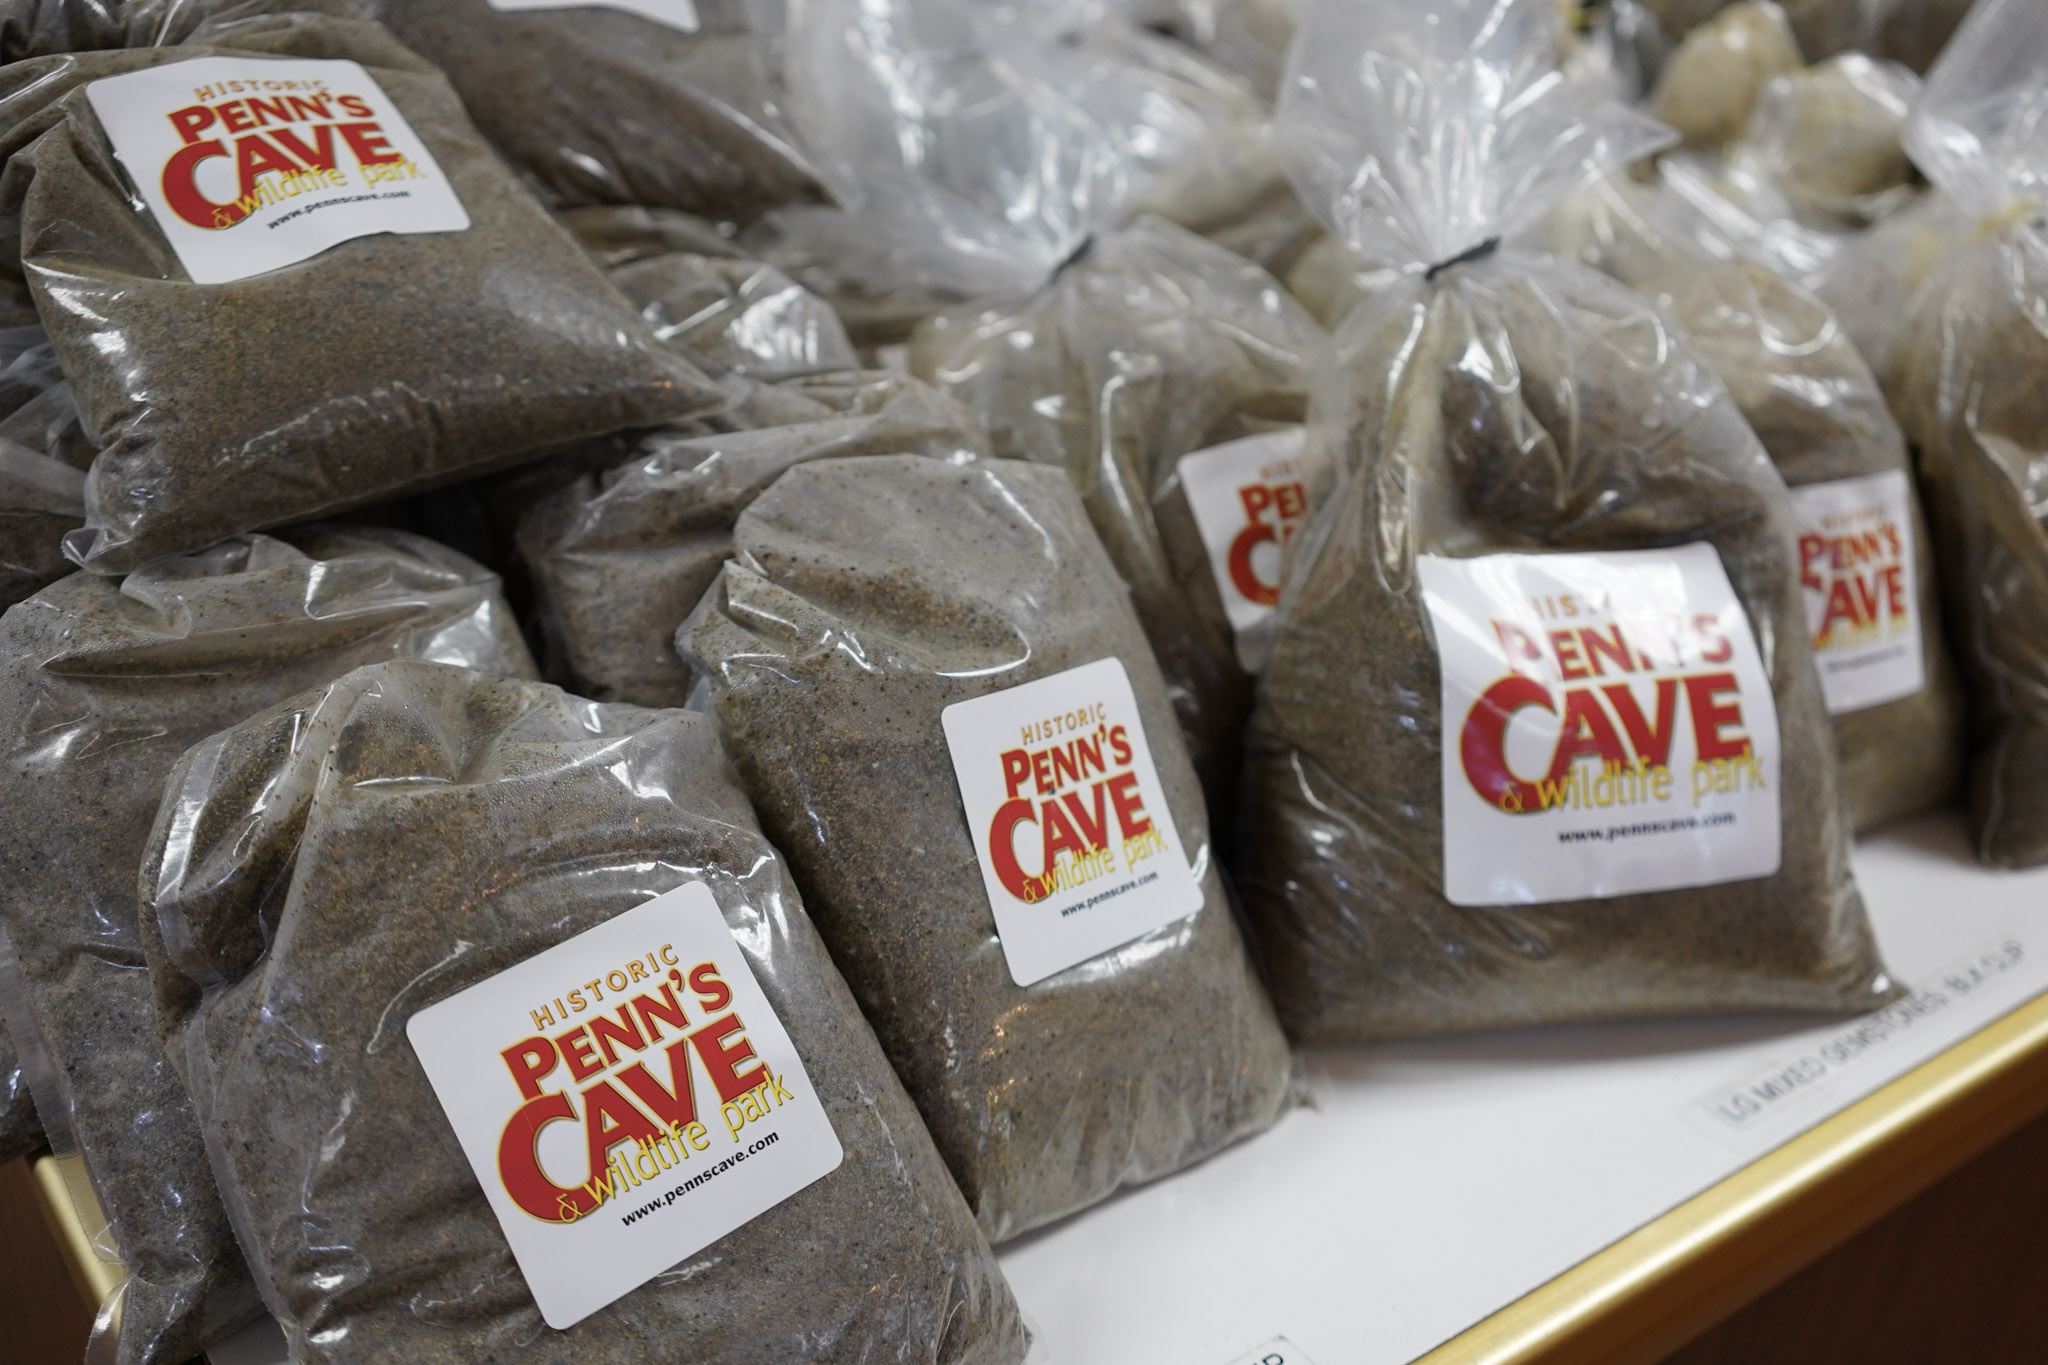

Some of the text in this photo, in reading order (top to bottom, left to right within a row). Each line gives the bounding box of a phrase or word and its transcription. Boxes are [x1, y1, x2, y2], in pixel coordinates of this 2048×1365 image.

[166, 89, 374, 145] PENN'S
[194, 79, 329, 102] HISTORIC
[161, 121, 404, 229] CAVE
[213, 159, 425, 230] & wildlife park
[267, 188, 412, 230] www.pennscave.com
[1000, 723, 1134, 799] PENN'S
[1020, 702, 1107, 746] HISTORIC
[1458, 671, 1752, 815] CAVE
[1500, 743, 1766, 814] & wildlife park
[988, 770, 1153, 905] CAVE
[1557, 811, 1737, 845] www.pennscave.com
[1022, 828, 1169, 905] & wildlife park
[1060, 870, 1159, 918] www.pennscave.com
[529, 943, 680, 1031] HISTORIC
[499, 961, 733, 1101] PENN'S
[496, 1012, 771, 1224] CAVE
[557, 1068, 795, 1224] & wildlife park
[620, 1130, 781, 1227] www.pennscave.com
